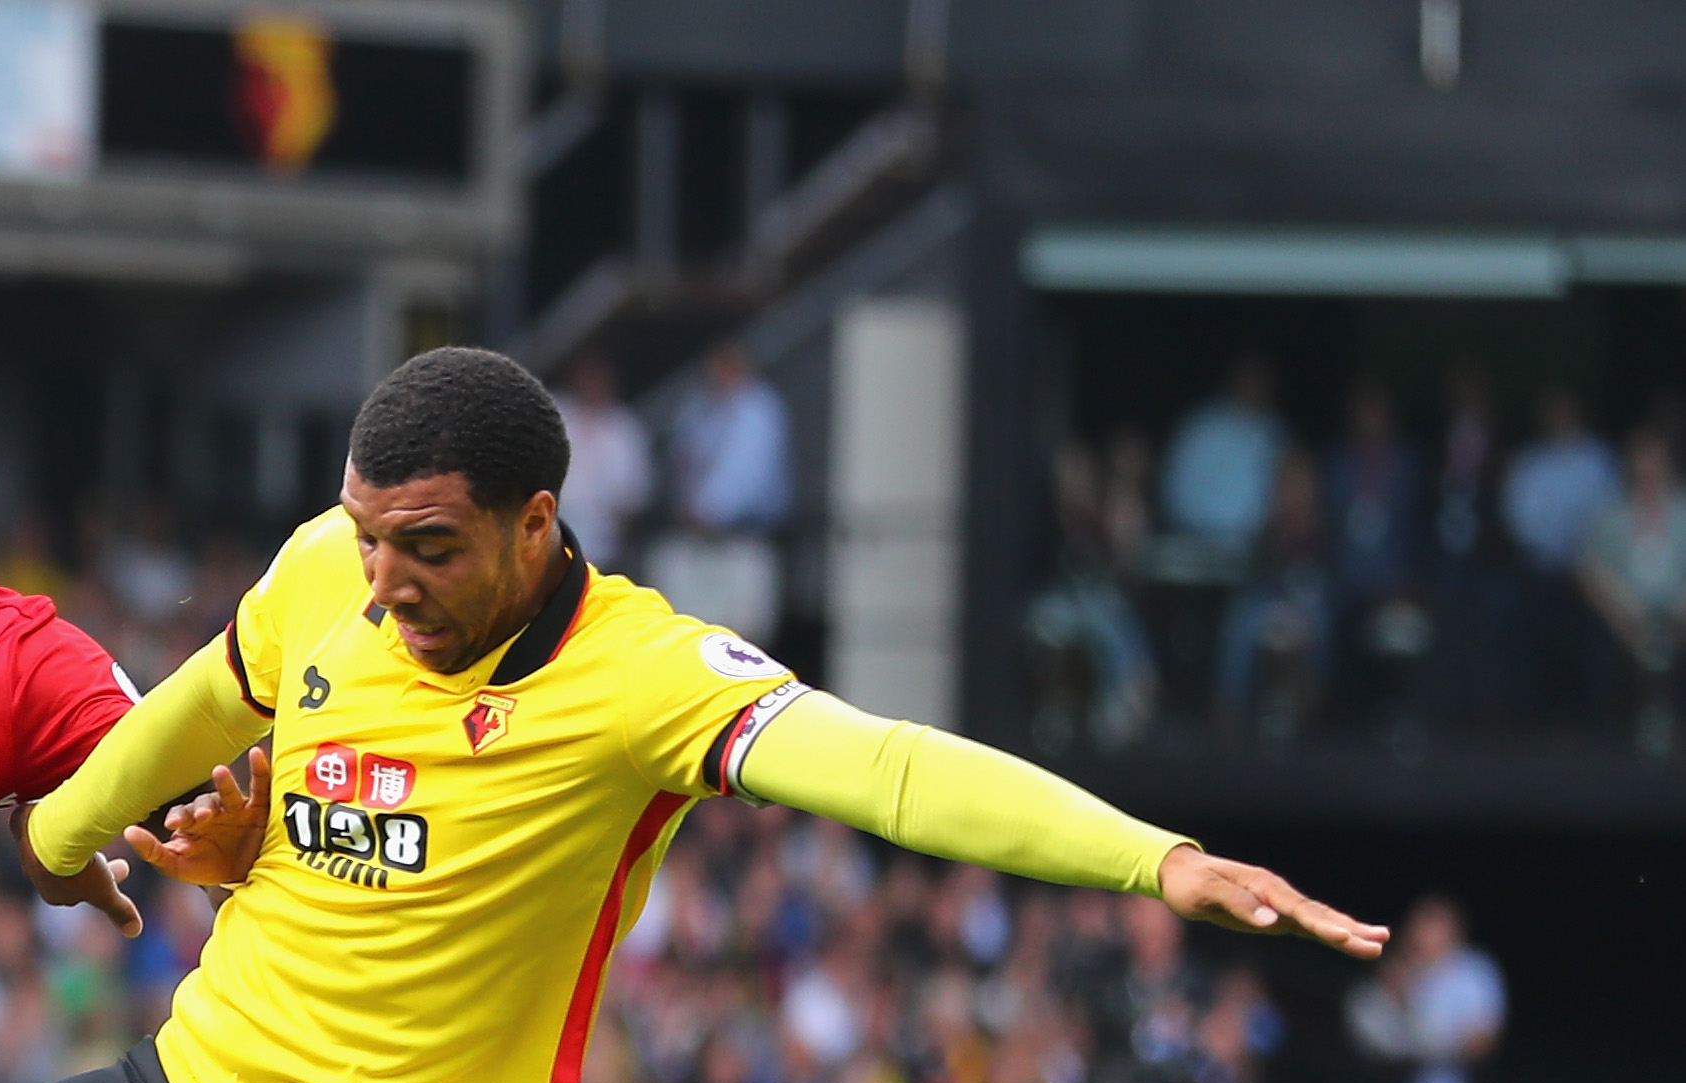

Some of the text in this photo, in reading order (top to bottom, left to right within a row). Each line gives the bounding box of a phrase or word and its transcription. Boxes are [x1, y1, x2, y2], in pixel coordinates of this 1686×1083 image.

[315, 752, 408, 805] 申博
[285, 798, 424, 868] 138
[296, 851, 388, 889] .com
